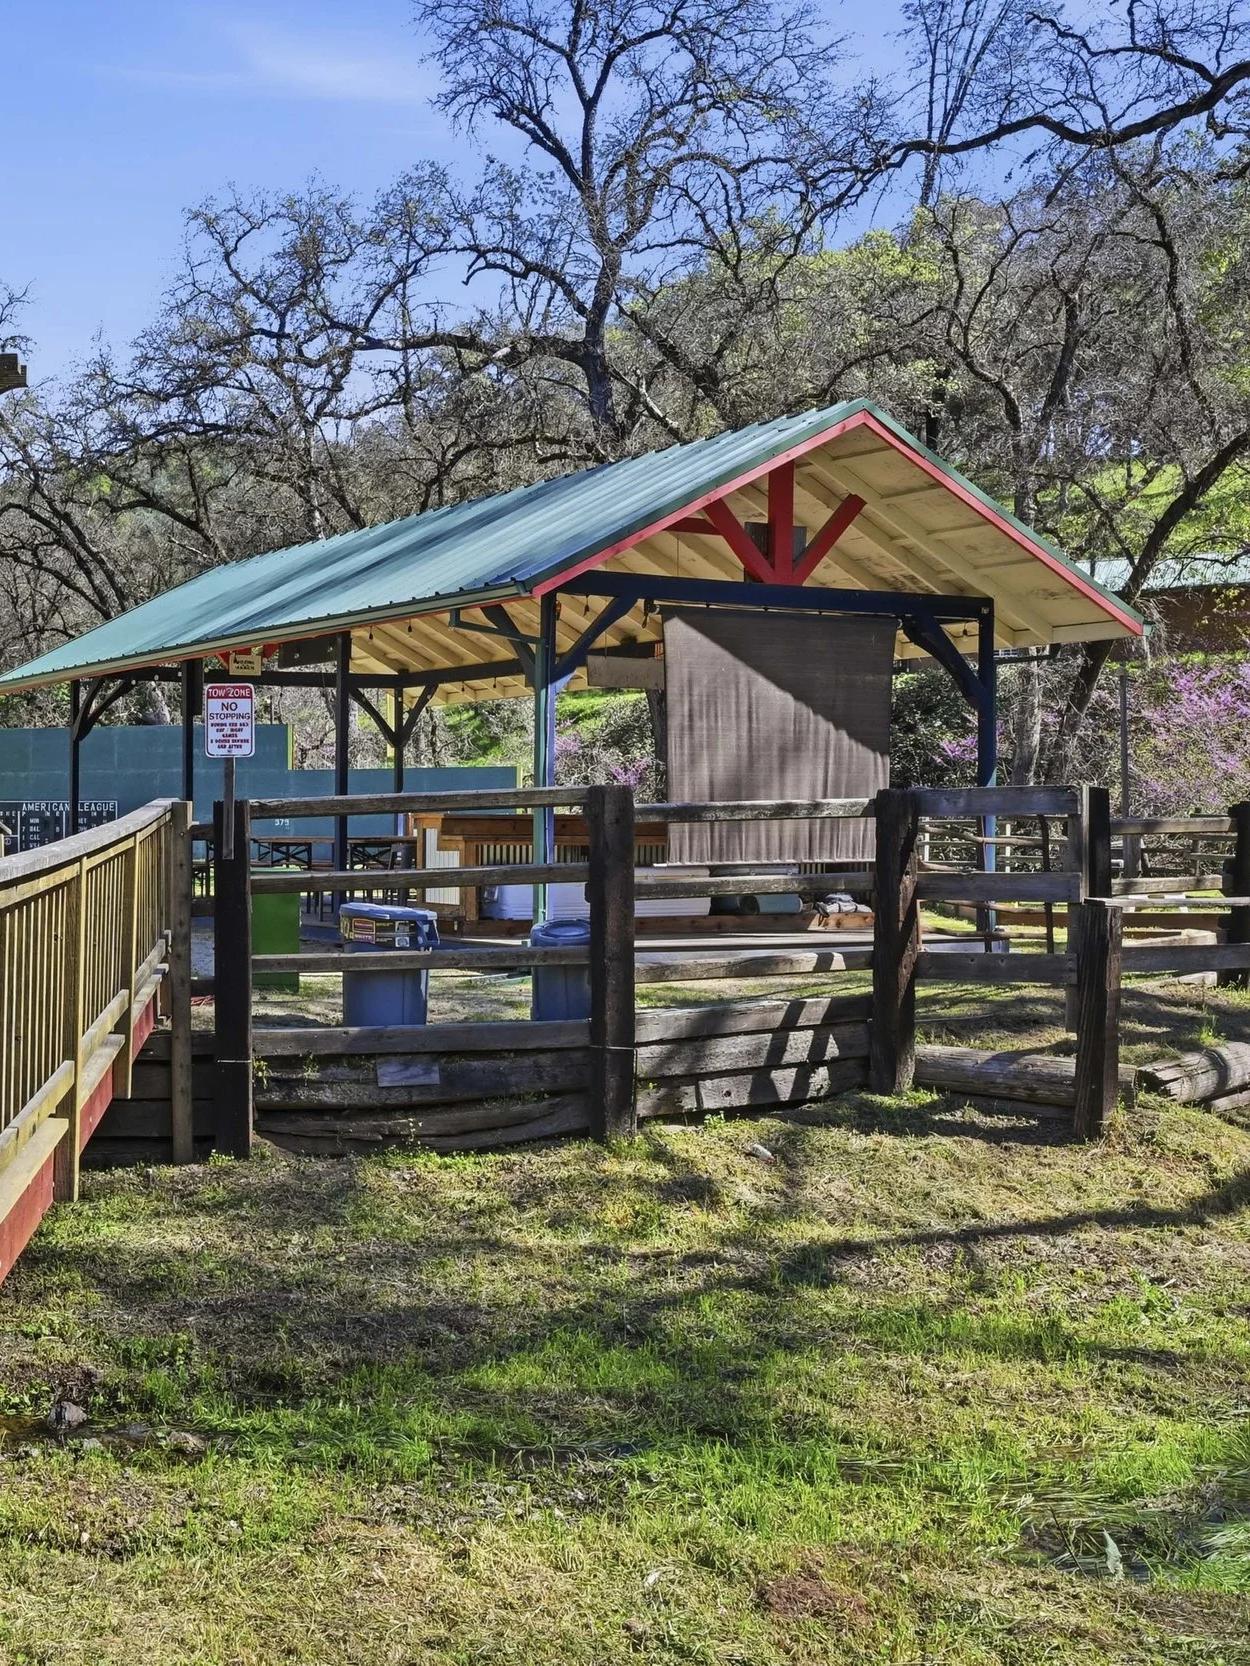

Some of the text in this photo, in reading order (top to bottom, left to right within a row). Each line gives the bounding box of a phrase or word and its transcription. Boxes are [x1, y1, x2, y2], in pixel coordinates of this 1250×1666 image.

[208, 688, 250, 697] TOW ZONE
[221, 702, 238, 711] NO
[209, 712, 250, 720] STOPPING
[22, 802, 115, 811] AMERICAN LEAGUE
